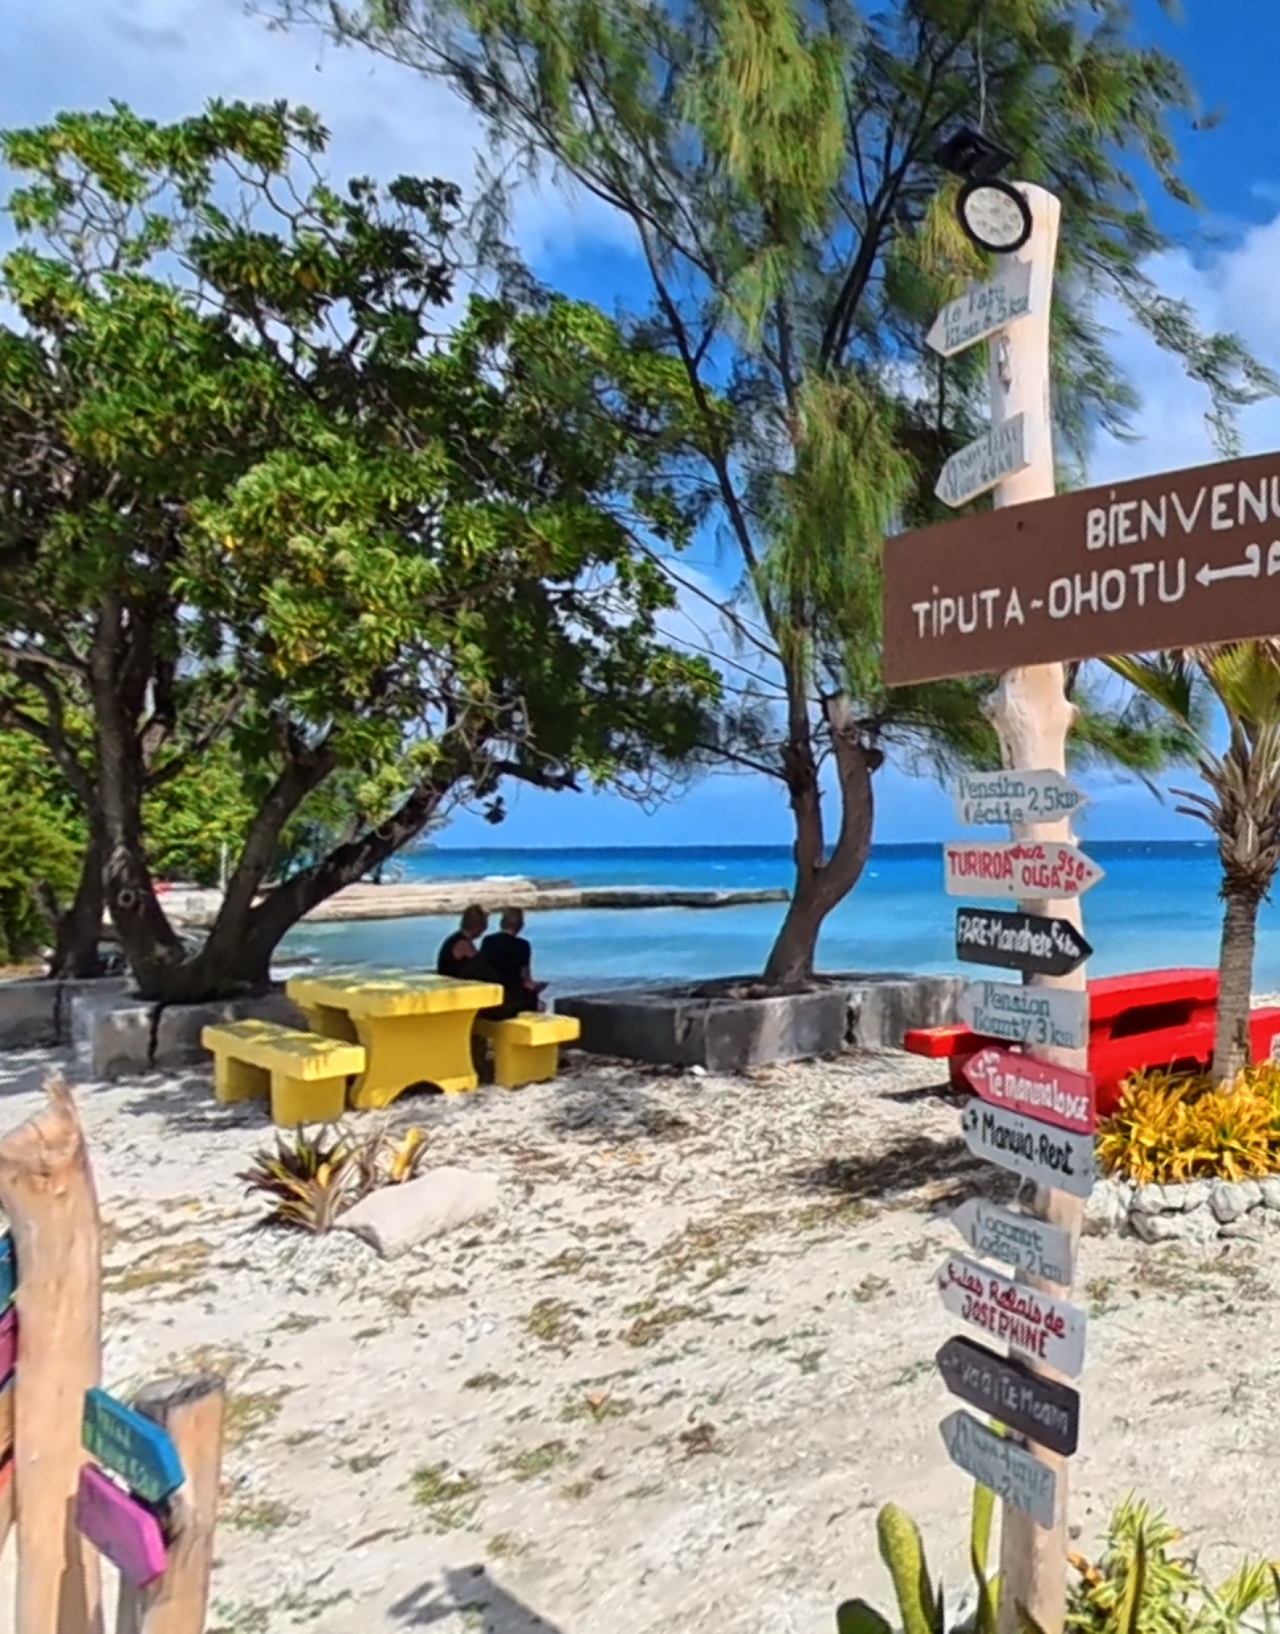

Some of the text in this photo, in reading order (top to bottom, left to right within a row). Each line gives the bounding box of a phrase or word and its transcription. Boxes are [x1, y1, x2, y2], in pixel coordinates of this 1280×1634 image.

[959, 776, 1025, 800] Pension
[1021, 864, 1061, 888] OLGA
[983, 981, 1049, 1018] Pension
